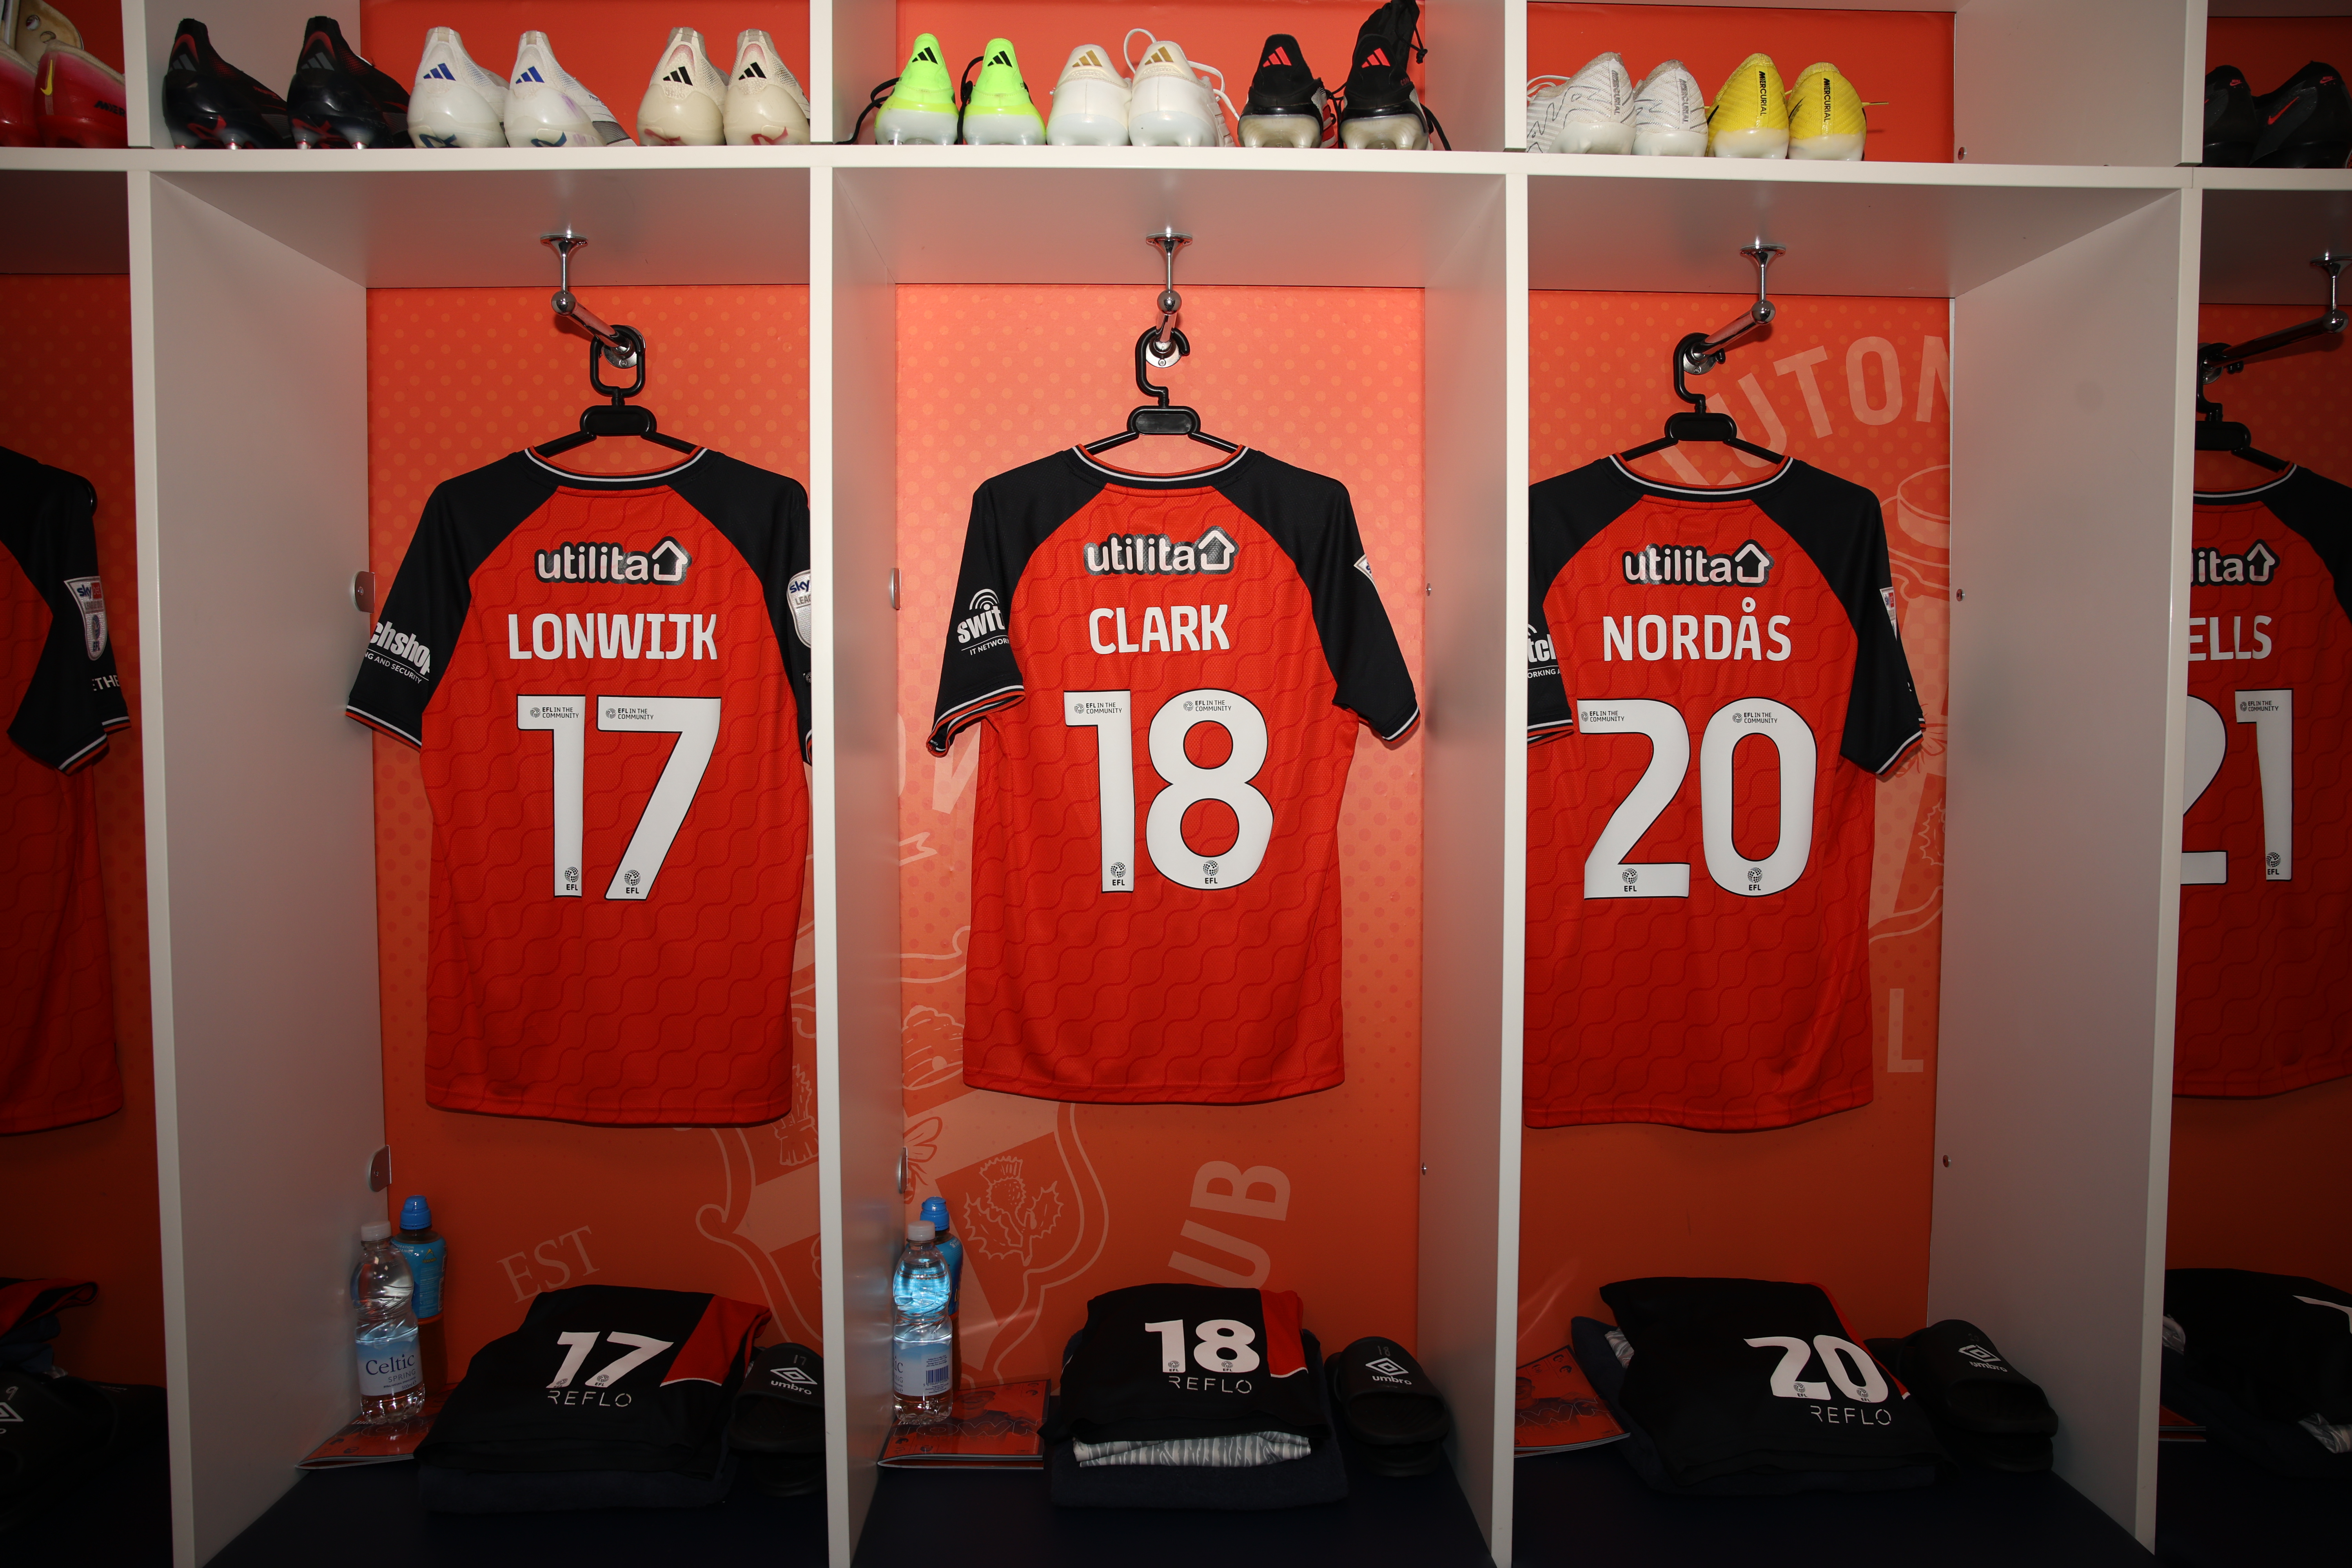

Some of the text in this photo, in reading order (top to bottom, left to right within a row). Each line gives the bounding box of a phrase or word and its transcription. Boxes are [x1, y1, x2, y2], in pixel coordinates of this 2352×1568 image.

[1612, 70, 1620, 115] MERCURIAL
[1679, 78, 1689, 124] MERCURIAL
[538, 546, 649, 581] utilita
[1087, 537, 1196, 571] utilita
[1625, 548, 1732, 583] utilita
[77, 584, 101, 598] sky bet
[789, 579, 810, 593] sky
[508, 613, 717, 660] LONWIJK
[1089, 604, 1230, 654] CLARK
[1603, 597, 1791, 661] NORDÅS
[2189, 615, 2272, 661] ELLS
[374, 656, 390, 667] AND
[391, 664, 422, 684] SECURITY
[1528, 669, 1556, 679] ORKING
[517, 694, 722, 900] 17
[1063, 688, 1274, 893] 18
[1577, 697, 1817, 900] 20
[2180, 688, 2294, 885] 21
[497, 1225, 600, 1303] EST
[546, 1331, 674, 1388] 17
[793, 1354, 807, 1366] 17
[1145, 1319, 1259, 1373] 18
[1377, 1345, 1391, 1357] 18
[366, 1354, 415, 1375] Celtic
[388, 1369, 416, 1383] SPRING
[1372, 1376, 1412, 1385] umbro
[1743, 1334, 1888, 1403] 20
[1969, 1361, 2007, 1372] umbro
[548, 1390, 632, 1407] REFLO
[771, 1380, 812, 1395] umbro
[1169, 1376, 1252, 1394] REFLO
[1810, 1405, 1891, 1425] REFLO
